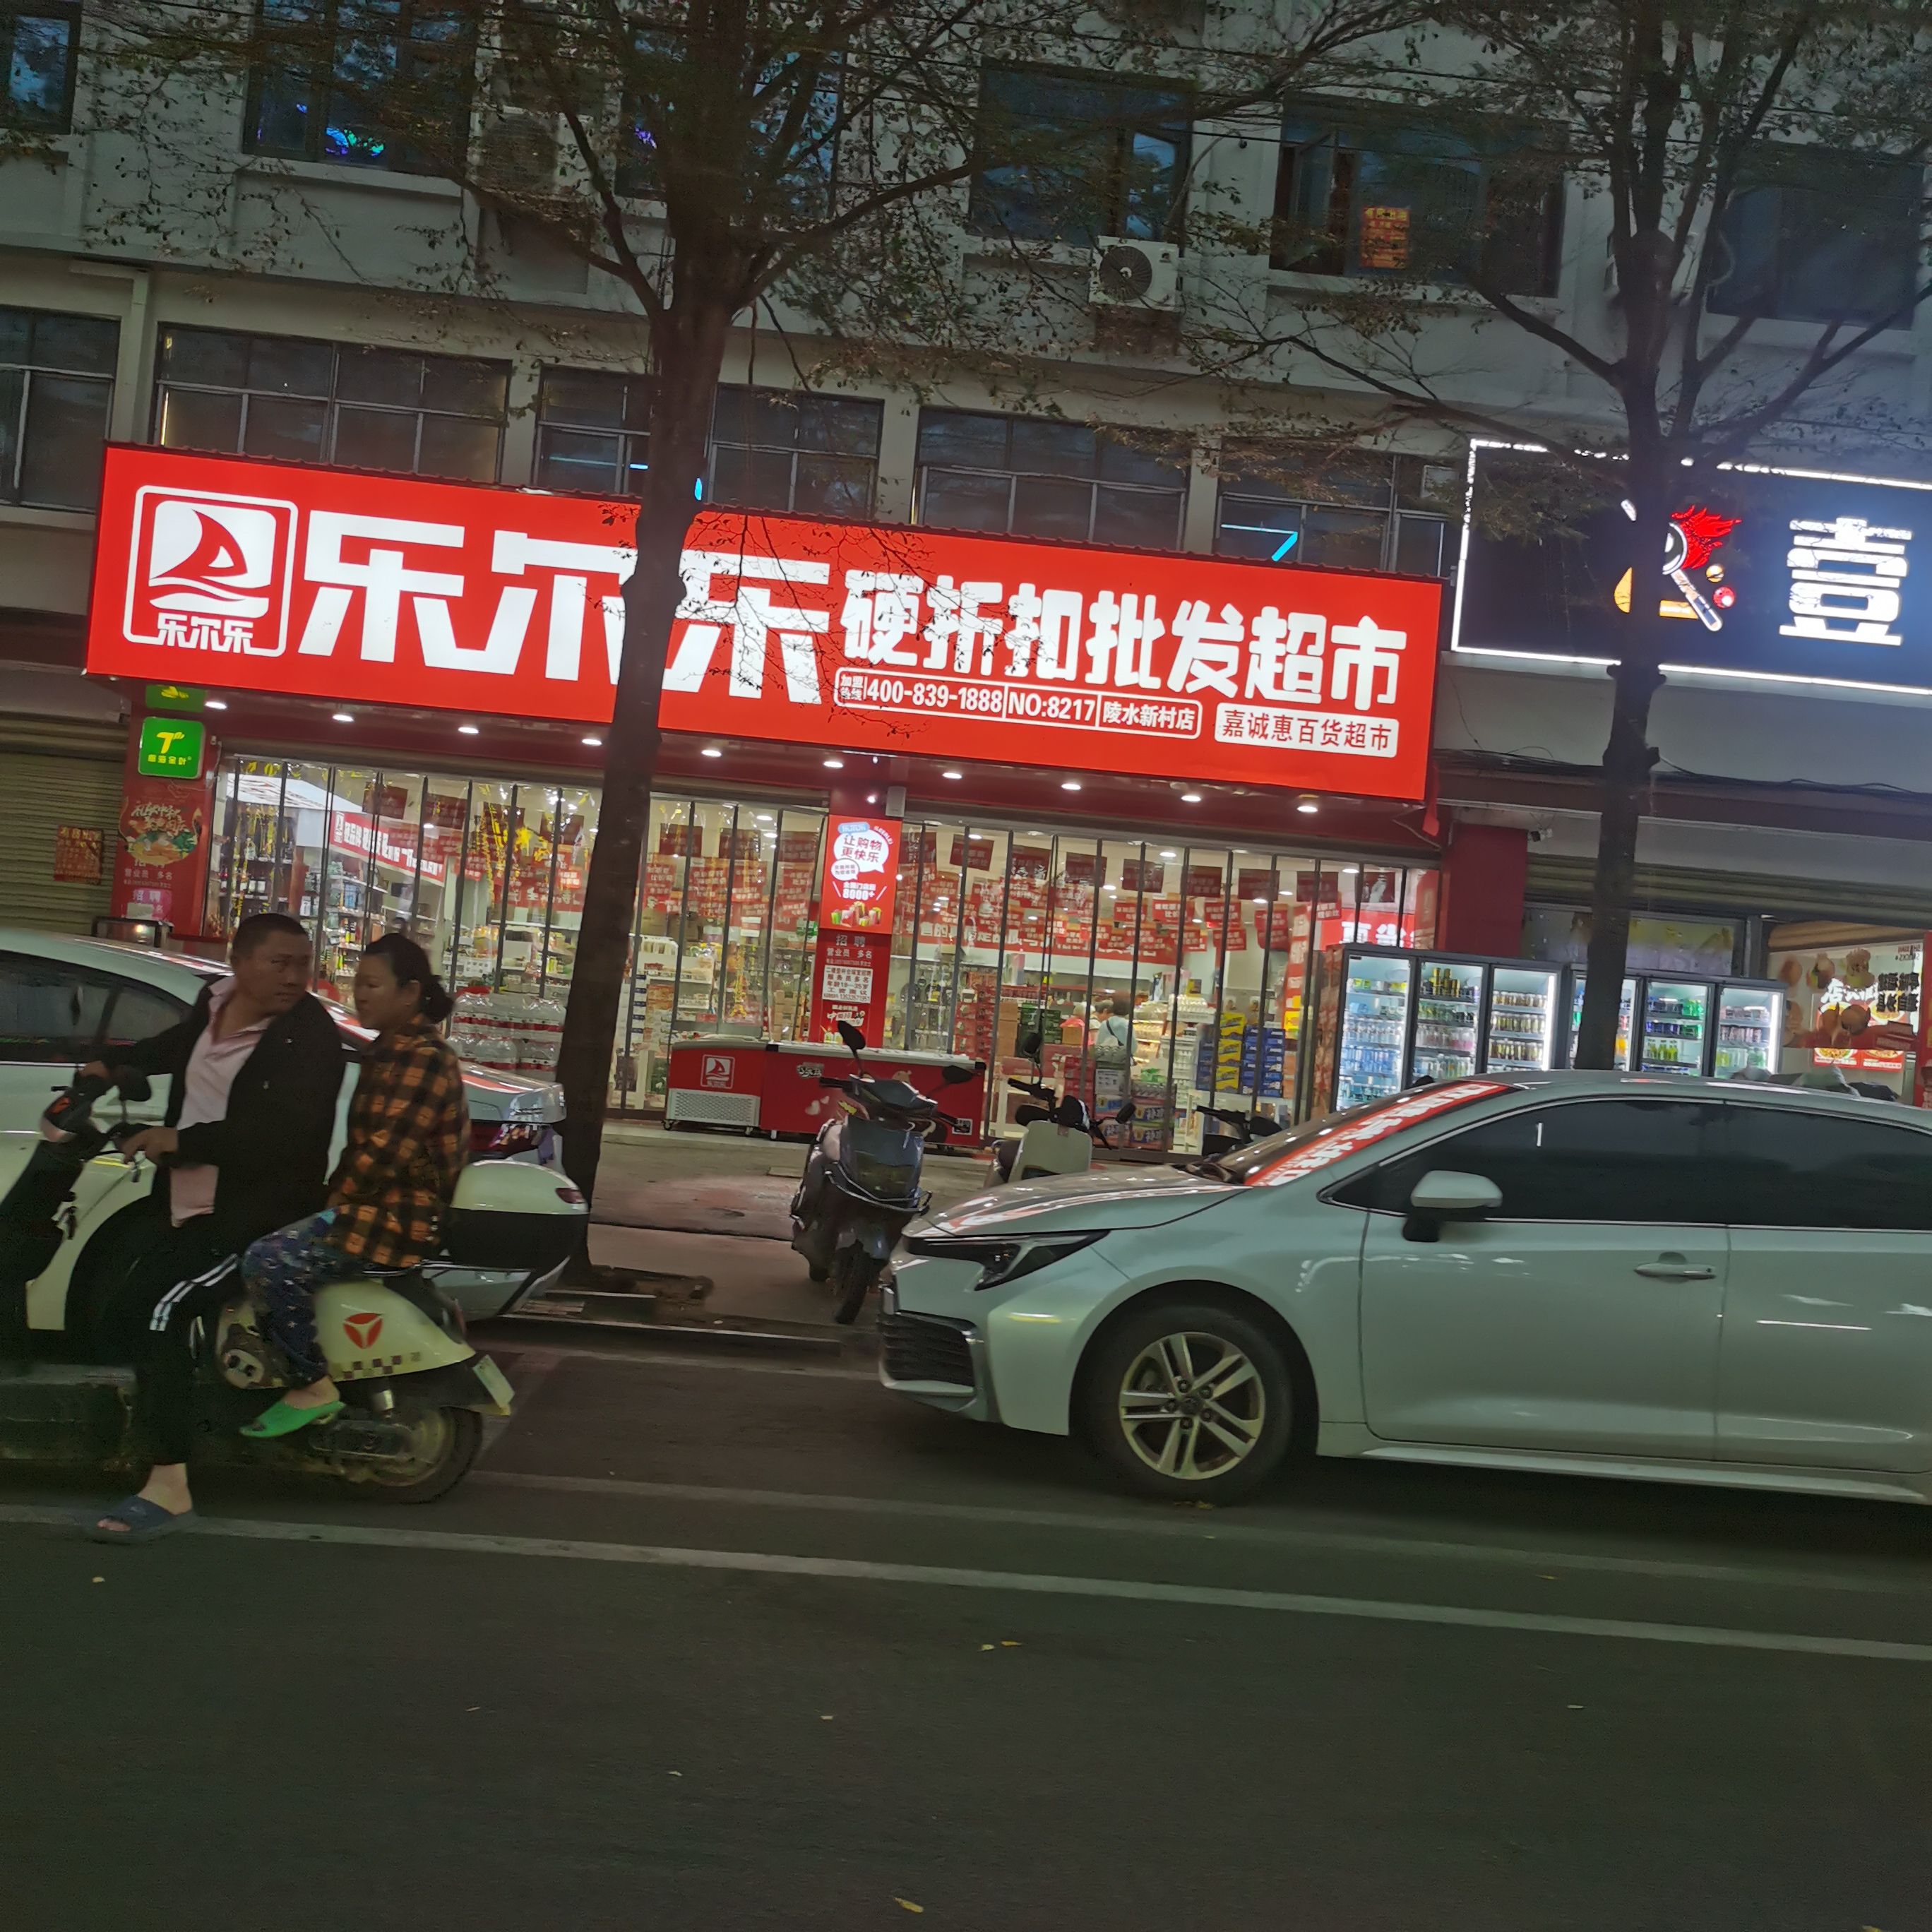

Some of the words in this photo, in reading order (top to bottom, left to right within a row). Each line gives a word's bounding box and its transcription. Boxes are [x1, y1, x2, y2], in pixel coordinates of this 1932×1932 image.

[157, 612, 254, 654] 乐尔乐
[840, 568, 1407, 711] 硬折扣批发超市
[867, 678, 1003, 713] 400-839-1888
[1008, 691, 1095, 723] NO:8217
[1102, 700, 1195, 732] 陵水新村店
[1222, 708, 1393, 751] 嘉诚惠百货超市
[840, 847, 880, 863] 更快乐
[843, 835, 883, 852] 让购物
[826, 948, 850, 958] 营业员
[857, 950, 873, 959] 多名
[836, 934, 866, 947] 招聘
